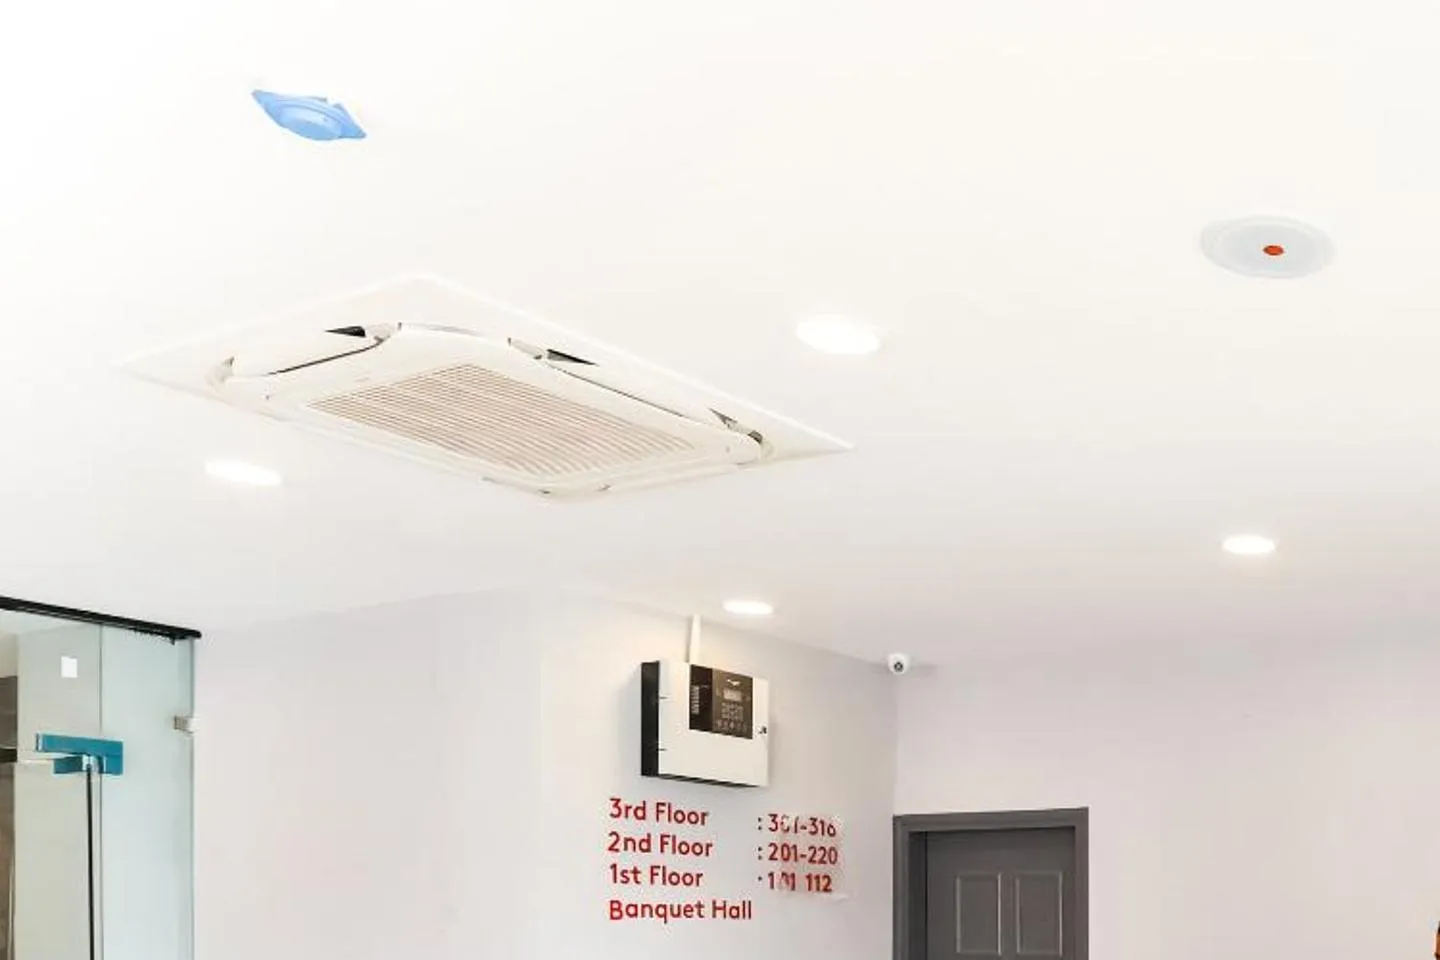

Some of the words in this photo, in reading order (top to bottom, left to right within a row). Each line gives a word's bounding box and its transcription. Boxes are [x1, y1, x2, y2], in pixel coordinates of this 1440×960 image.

[609, 798, 646, 821] 3rd
[656, 802, 709, 826] Floor
[608, 831, 652, 853] 2nd
[660, 834, 713, 857] Floor
[768, 842, 838, 864] 201-220
[609, 863, 641, 884] 1st
[650, 865, 703, 887] Floor
[609, 899, 705, 924] Banquet
[711, 899, 752, 920] Hall
